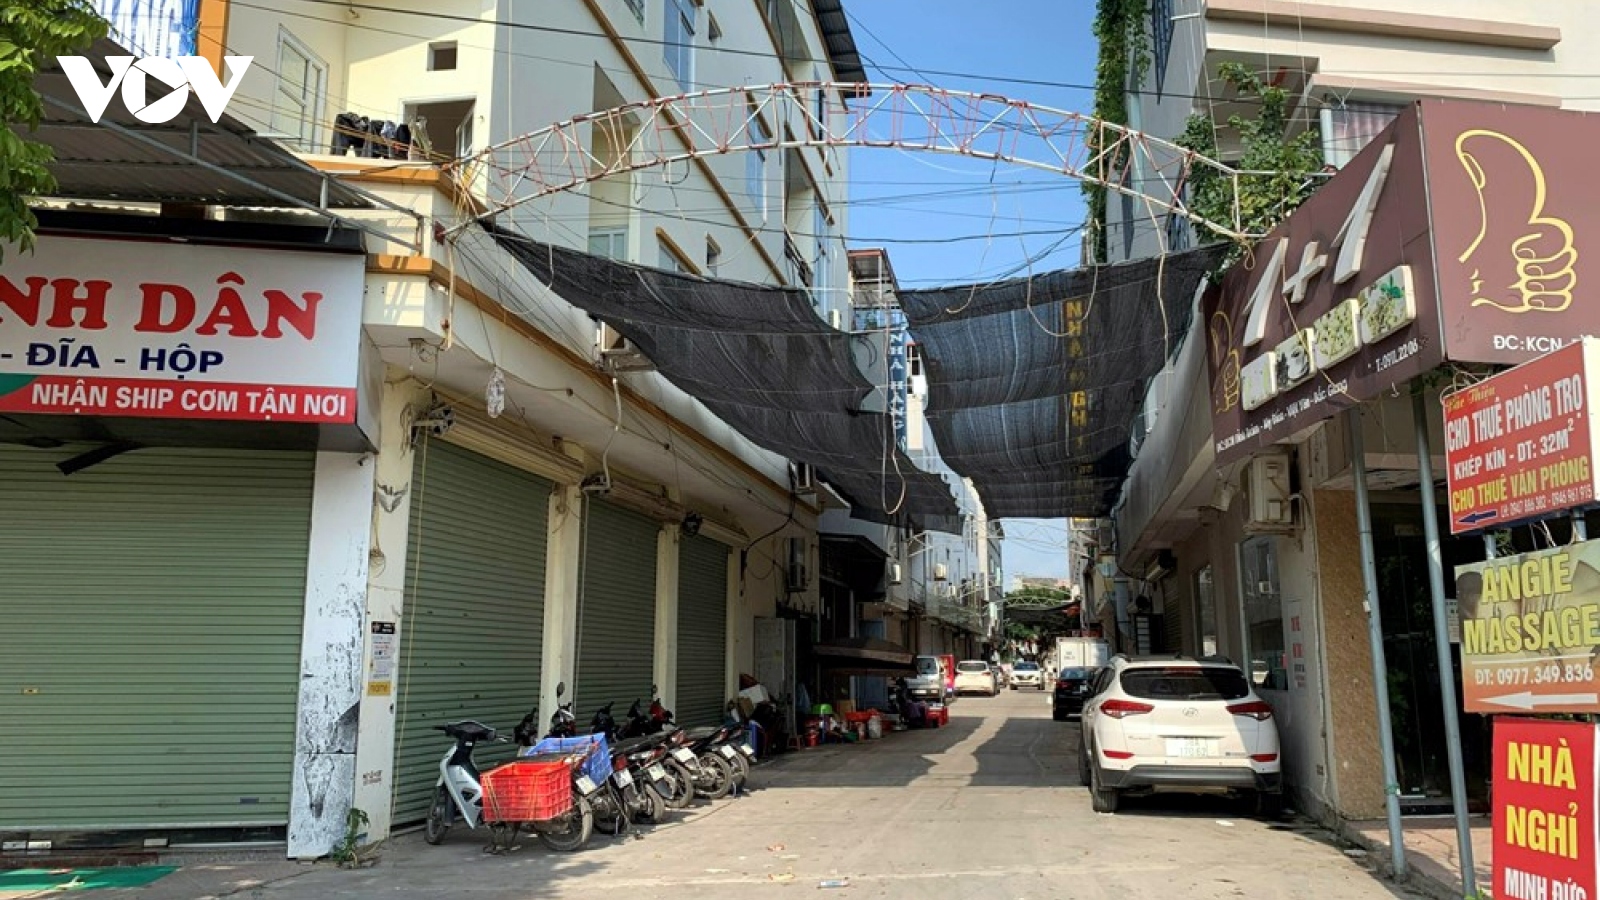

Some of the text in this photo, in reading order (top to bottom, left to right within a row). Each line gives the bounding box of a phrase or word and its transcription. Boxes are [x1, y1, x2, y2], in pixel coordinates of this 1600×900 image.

[1242, 143, 1395, 347] 1+1
[134, 271, 324, 341] DÂN
[26, 338, 100, 369] ĐĨA
[140, 343, 224, 380] HỘP
[31, 379, 347, 421] NHẬN SHIP CƠM TẬN NƠI
[1447, 373, 1583, 452] CHO THUÊ PHÒNG TRỌ
[1452, 455, 1589, 512] CHO THUÊ VĂN PHÒNG
[1454, 454, 1482, 480] KHÉP
[1485, 447, 1506, 471] KÍN
[1481, 553, 1572, 603] ANGIE
[1464, 604, 1600, 654] MASSAGE
[1475, 662, 1594, 685] ĐT: 0977.349.836
[1507, 738, 1577, 790] NHÀ
[1506, 802, 1578, 859] NGHỈ
[1505, 867, 1548, 900] MINH
